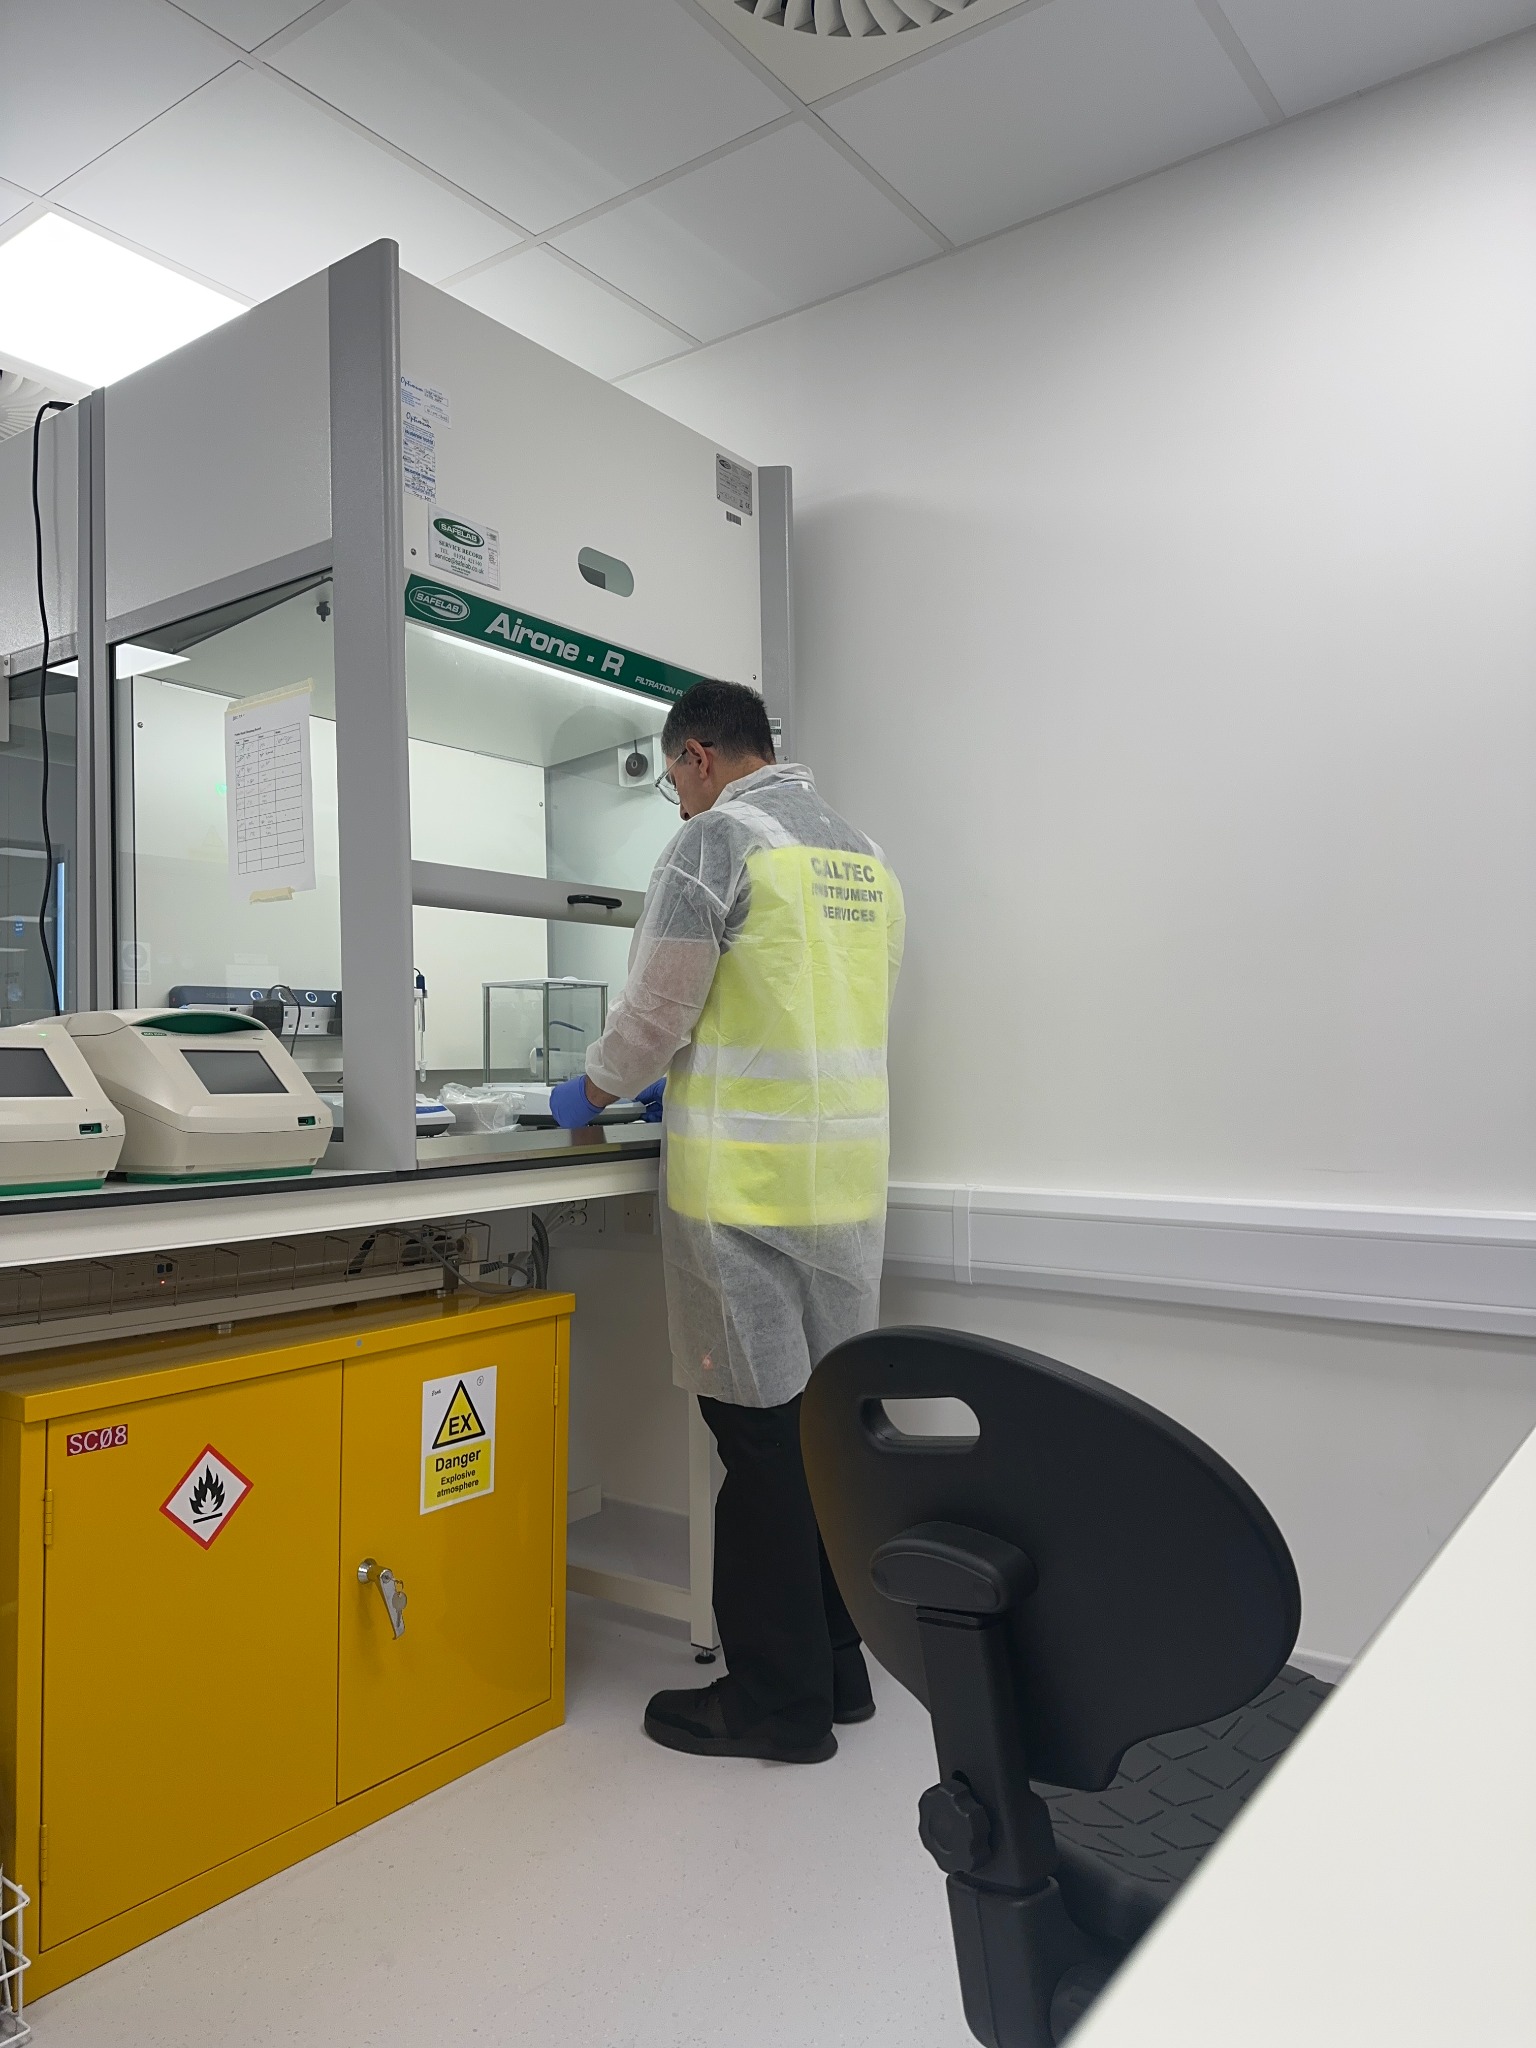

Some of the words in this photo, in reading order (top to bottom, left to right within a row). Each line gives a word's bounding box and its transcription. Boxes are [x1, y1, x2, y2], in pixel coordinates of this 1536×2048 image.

[441, 523, 478, 542] SAFELAB
[439, 540, 461, 552] SERVICE
[462, 547, 483, 560] RECORD
[416, 591, 461, 615] SAFELAB
[485, 611, 580, 662] Airone
[601, 649, 625, 676] R
[635, 675, 676, 695] FILTRATION
[810, 857, 875, 883] CALTEC
[812, 882, 883, 903] INSTRUMENT
[823, 905, 876, 922] SERVICES
[449, 1412, 472, 1436] EX
[435, 1449, 482, 1473] Danger
[440, 1469, 476, 1486] Explosive
[436, 1479, 479, 1498] atmosphere
